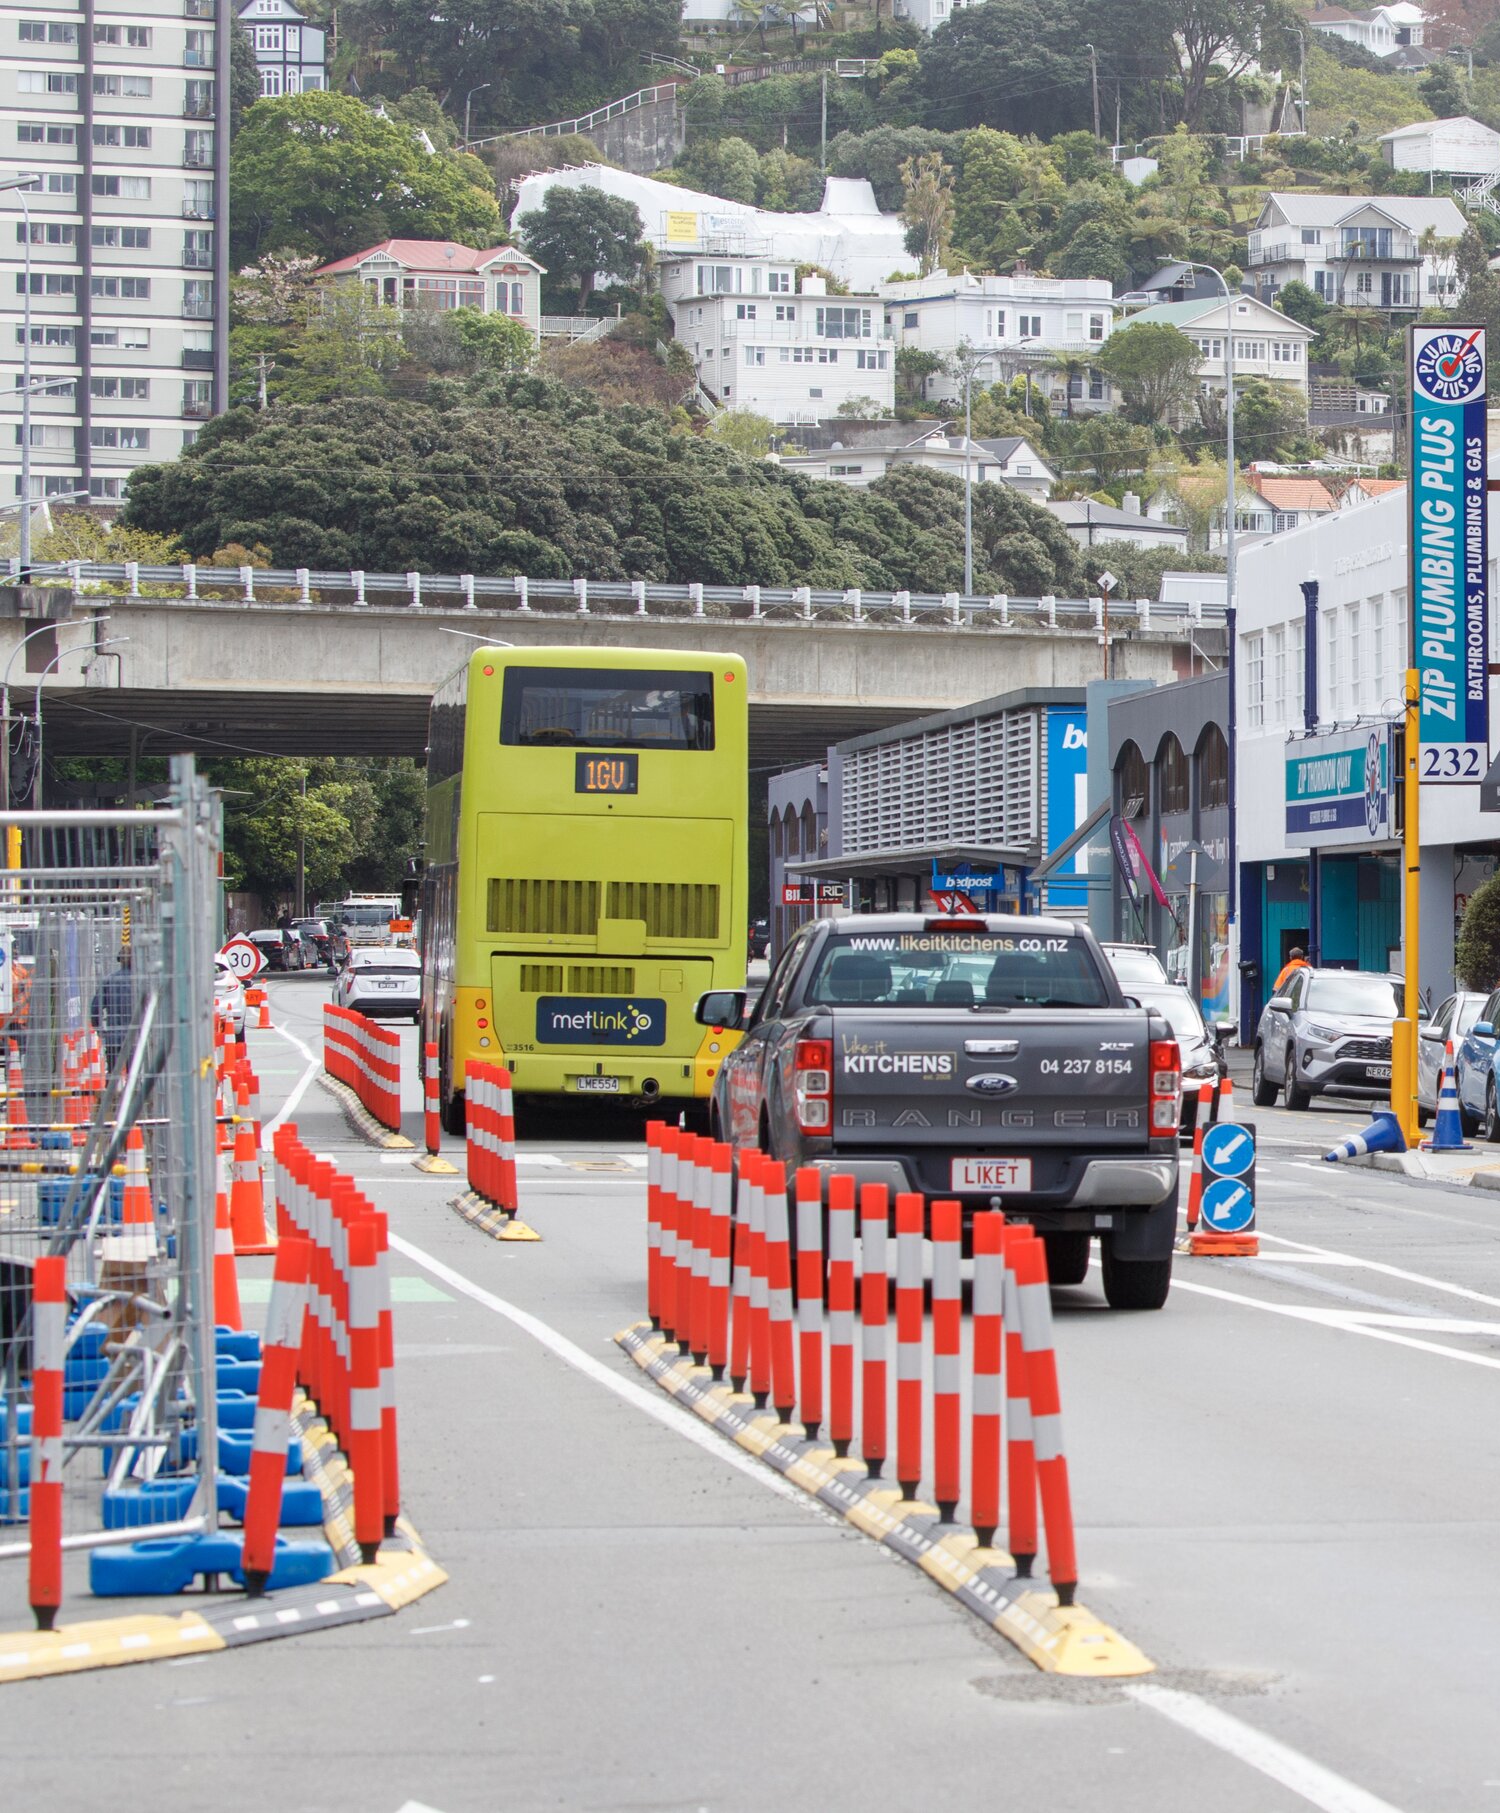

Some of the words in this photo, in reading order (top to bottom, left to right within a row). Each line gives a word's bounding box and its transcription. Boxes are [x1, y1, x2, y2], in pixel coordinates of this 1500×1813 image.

[1419, 337, 1481, 374] PLUMBING
[1431, 378, 1469, 398] PLUS
[1421, 417, 1455, 492] PLUS
[1467, 437, 1482, 471] GAS
[1467, 477, 1482, 490] &
[1467, 495, 1482, 584] PLUMBING
[1421, 500, 1455, 662] PLUMBING
[1467, 589, 1483, 700] BATHROOMS,
[1422, 667, 1456, 721] ZIP
[1424, 748, 1481, 777] 232
[1297, 763, 1306, 794] ZIP
[945, 876, 993, 889] bedpost
[850, 936, 1069, 953] www.likeitkitchens.co.nz
[230, 952, 251, 968] 30
[551, 1009, 628, 1031] metlink
[841, 1033, 888, 1054] Like-it
[1099, 1042, 1134, 1051] XLT
[844, 1055, 952, 1073] KITCHENS
[1040, 1059, 1059, 1073] 04
[1063, 1059, 1091, 1073] 237
[1096, 1059, 1132, 1073] 8154
[1366, 1068, 1392, 1077] NER42
[578, 1078, 617, 1090] LME554
[842, 1108, 1140, 1128] RANGER
[964, 1166, 1019, 1184] LIKET
